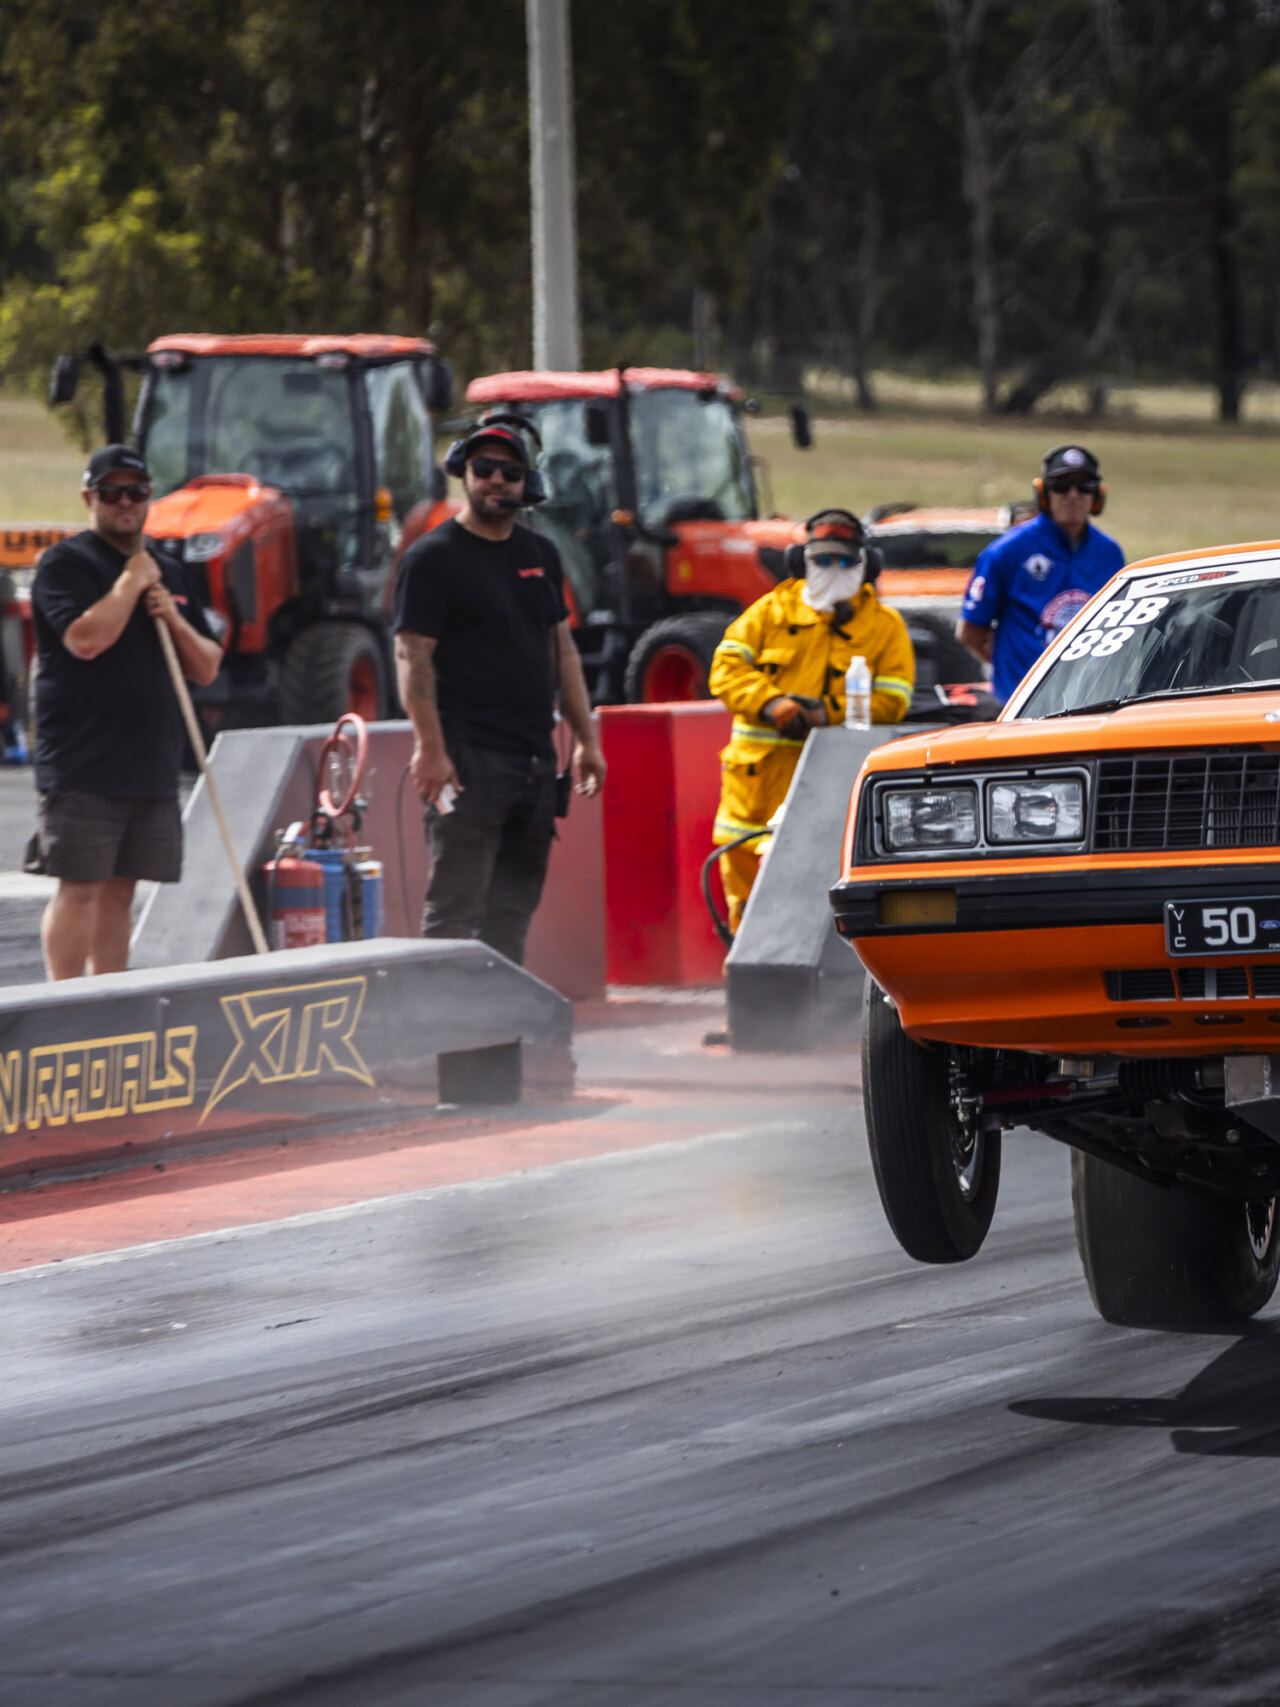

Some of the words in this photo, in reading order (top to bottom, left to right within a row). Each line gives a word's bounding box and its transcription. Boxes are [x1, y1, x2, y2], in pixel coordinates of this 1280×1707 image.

[1086, 597, 1170, 631] RB
[1060, 626, 1135, 662] 88
[1173, 909, 1187, 948] VIC
[1202, 906, 1256, 946] 50
